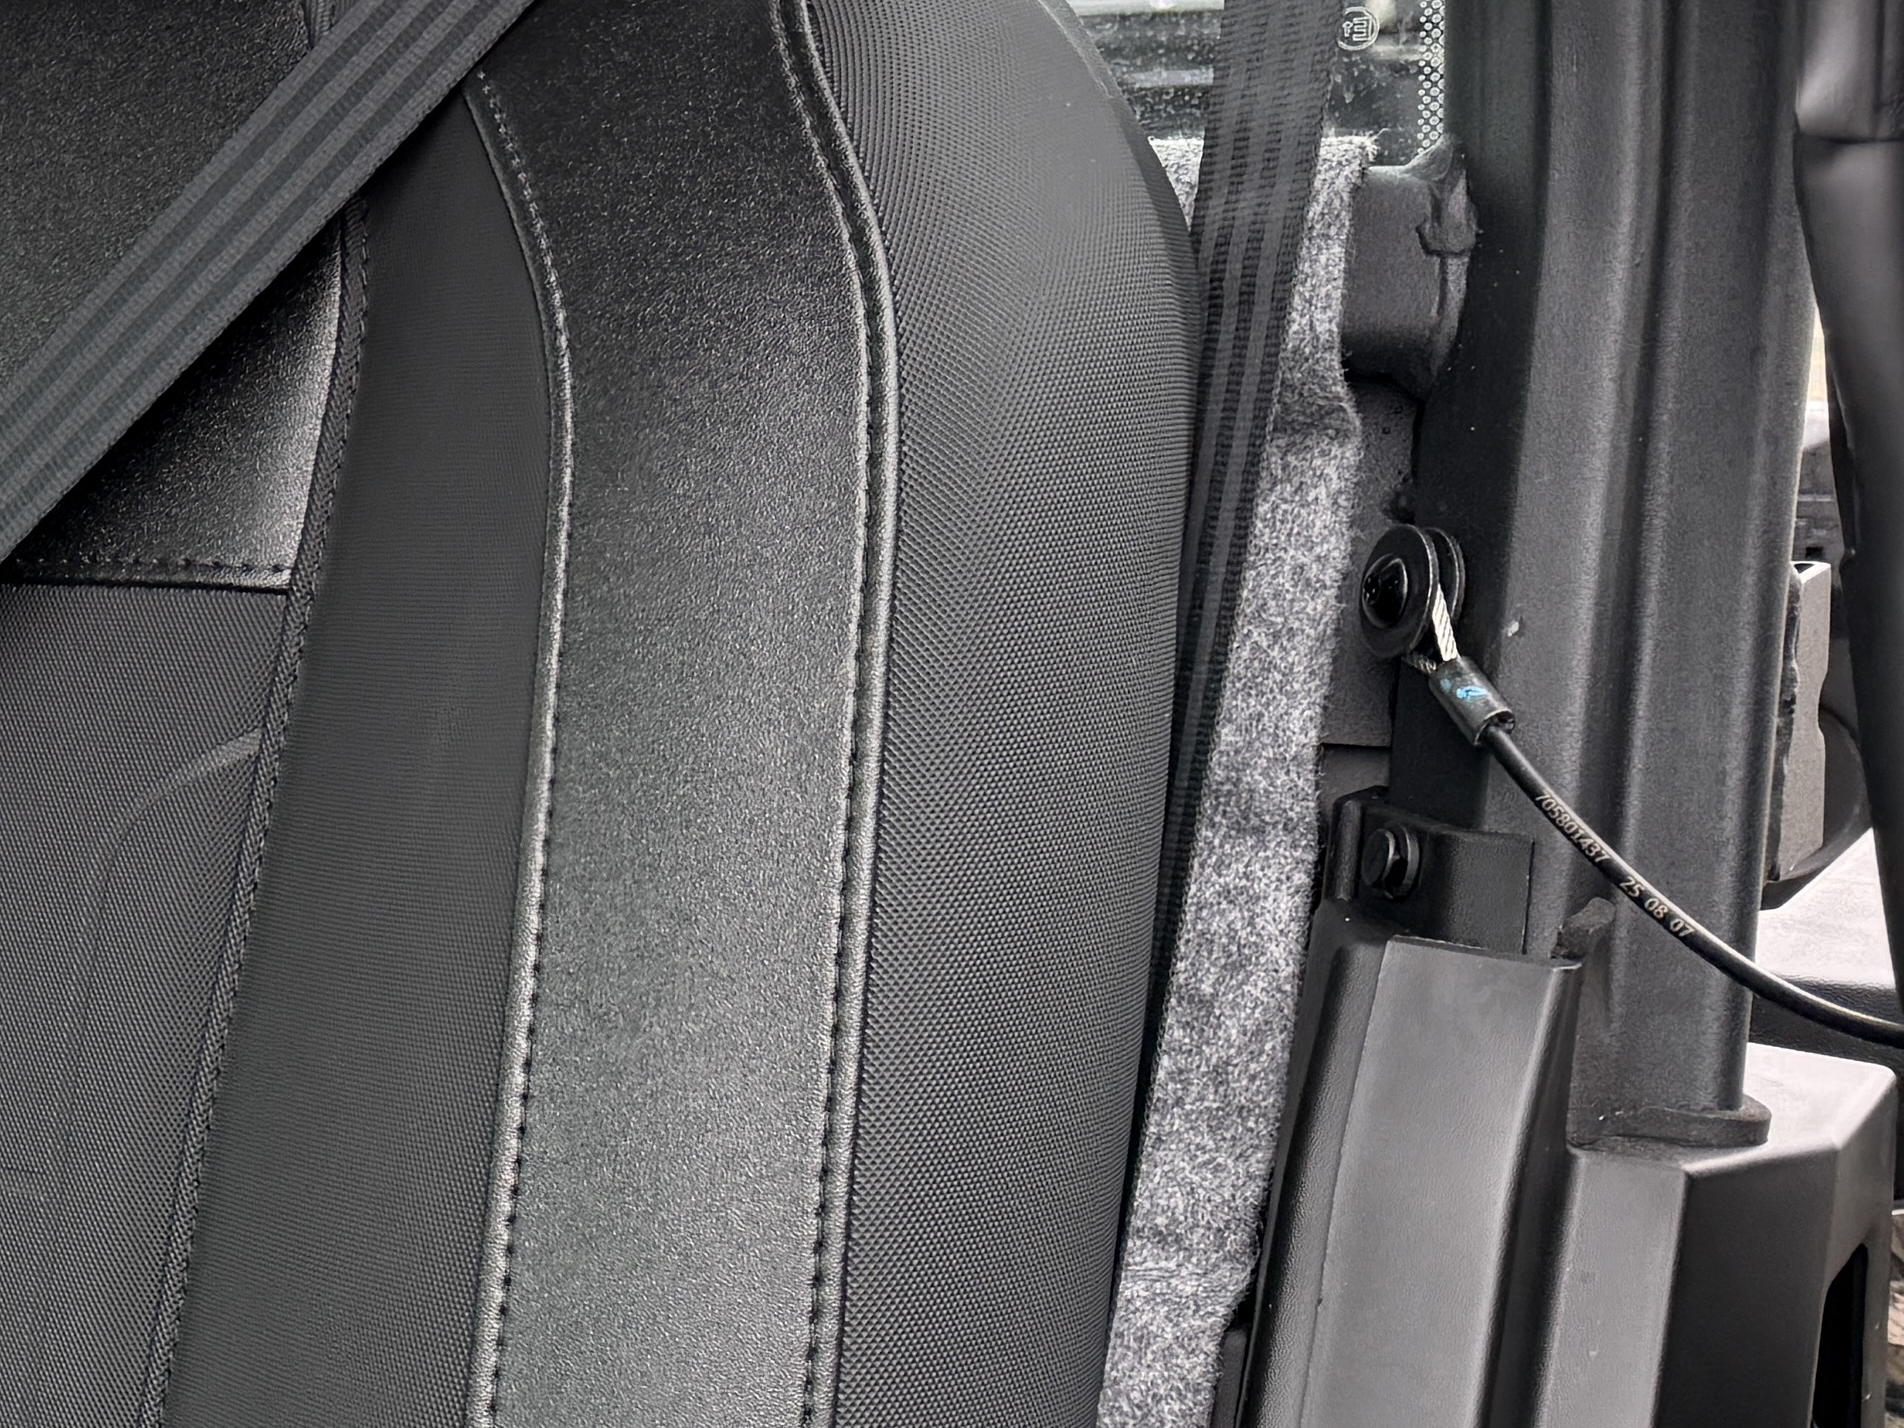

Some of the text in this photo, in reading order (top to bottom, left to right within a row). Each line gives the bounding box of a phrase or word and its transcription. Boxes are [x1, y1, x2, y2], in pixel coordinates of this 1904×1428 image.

[1535, 793, 1695, 938] 705801437 25 08 07
